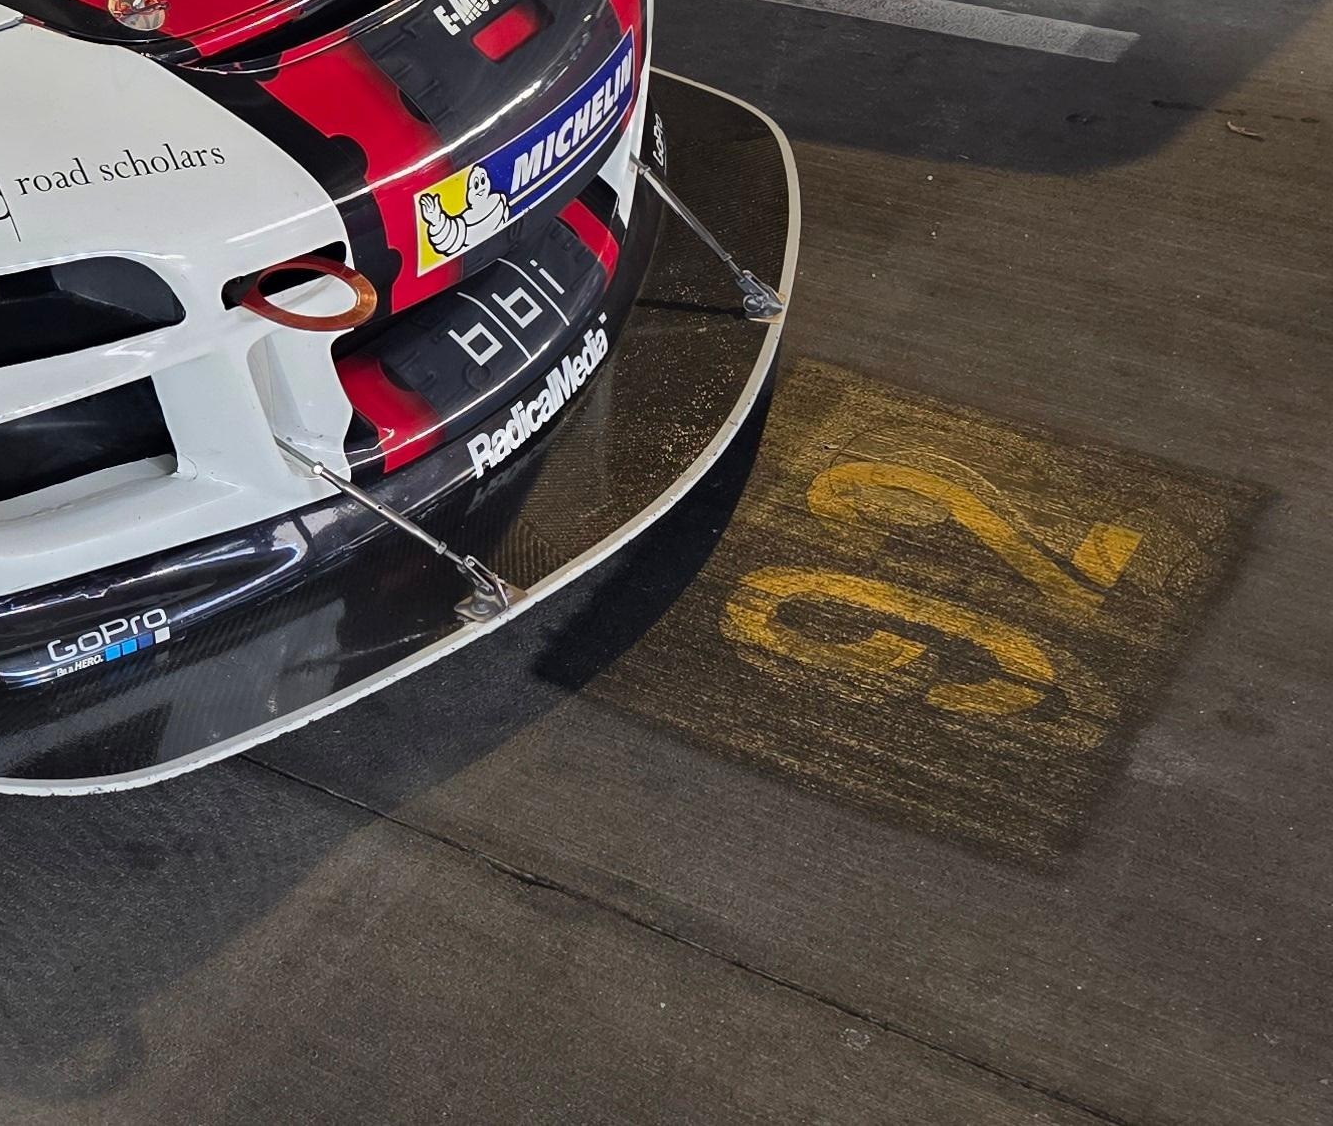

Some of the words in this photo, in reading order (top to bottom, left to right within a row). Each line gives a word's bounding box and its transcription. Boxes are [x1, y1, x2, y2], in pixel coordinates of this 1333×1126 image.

[509, 47, 633, 196] MICHELIN
[14, 156, 92, 197] road
[98, 142, 227, 183] scholars
[46, 607, 168, 662] GoPro
